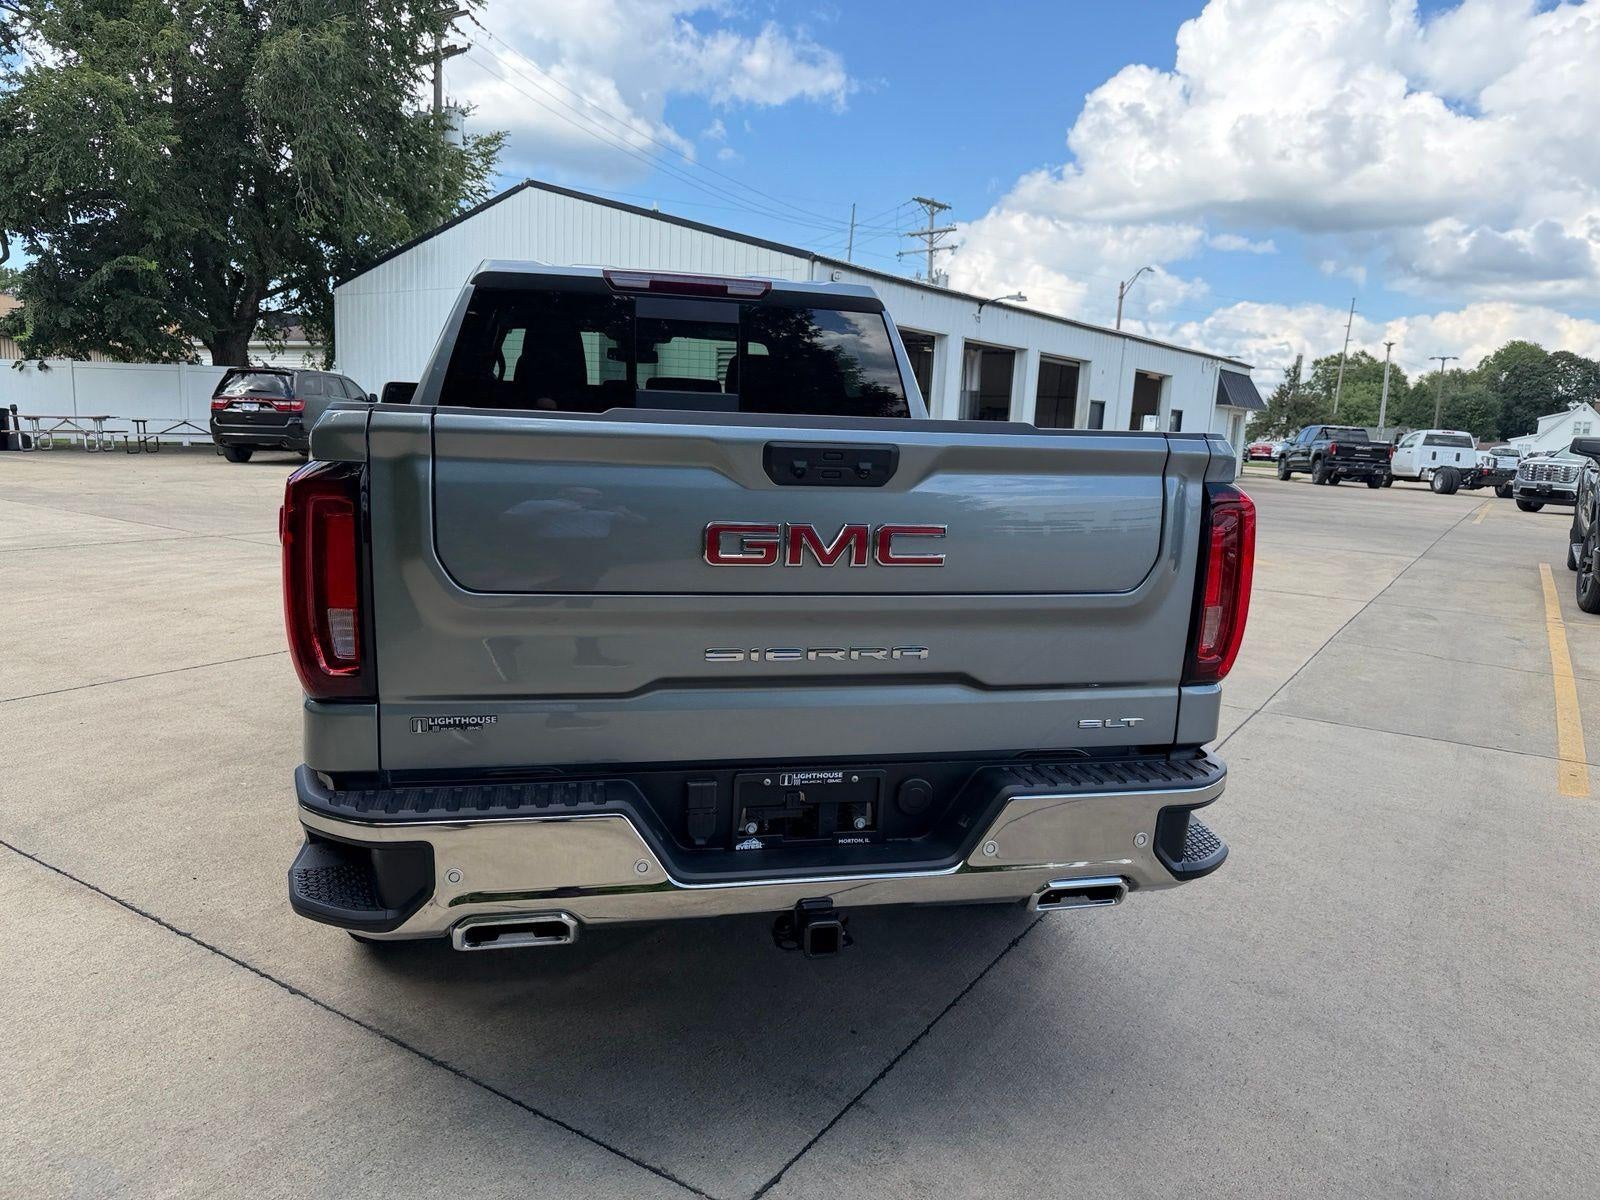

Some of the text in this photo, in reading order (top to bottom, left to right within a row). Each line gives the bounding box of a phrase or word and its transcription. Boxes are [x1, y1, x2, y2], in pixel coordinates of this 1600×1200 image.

[703, 521, 948, 568] GMC
[705, 645, 929, 663] SIERRA
[428, 716, 497, 725] LIGHTHOUSE
[1078, 717, 1145, 729] SLT
[793, 771, 843, 779] LIGHTHOUSE
